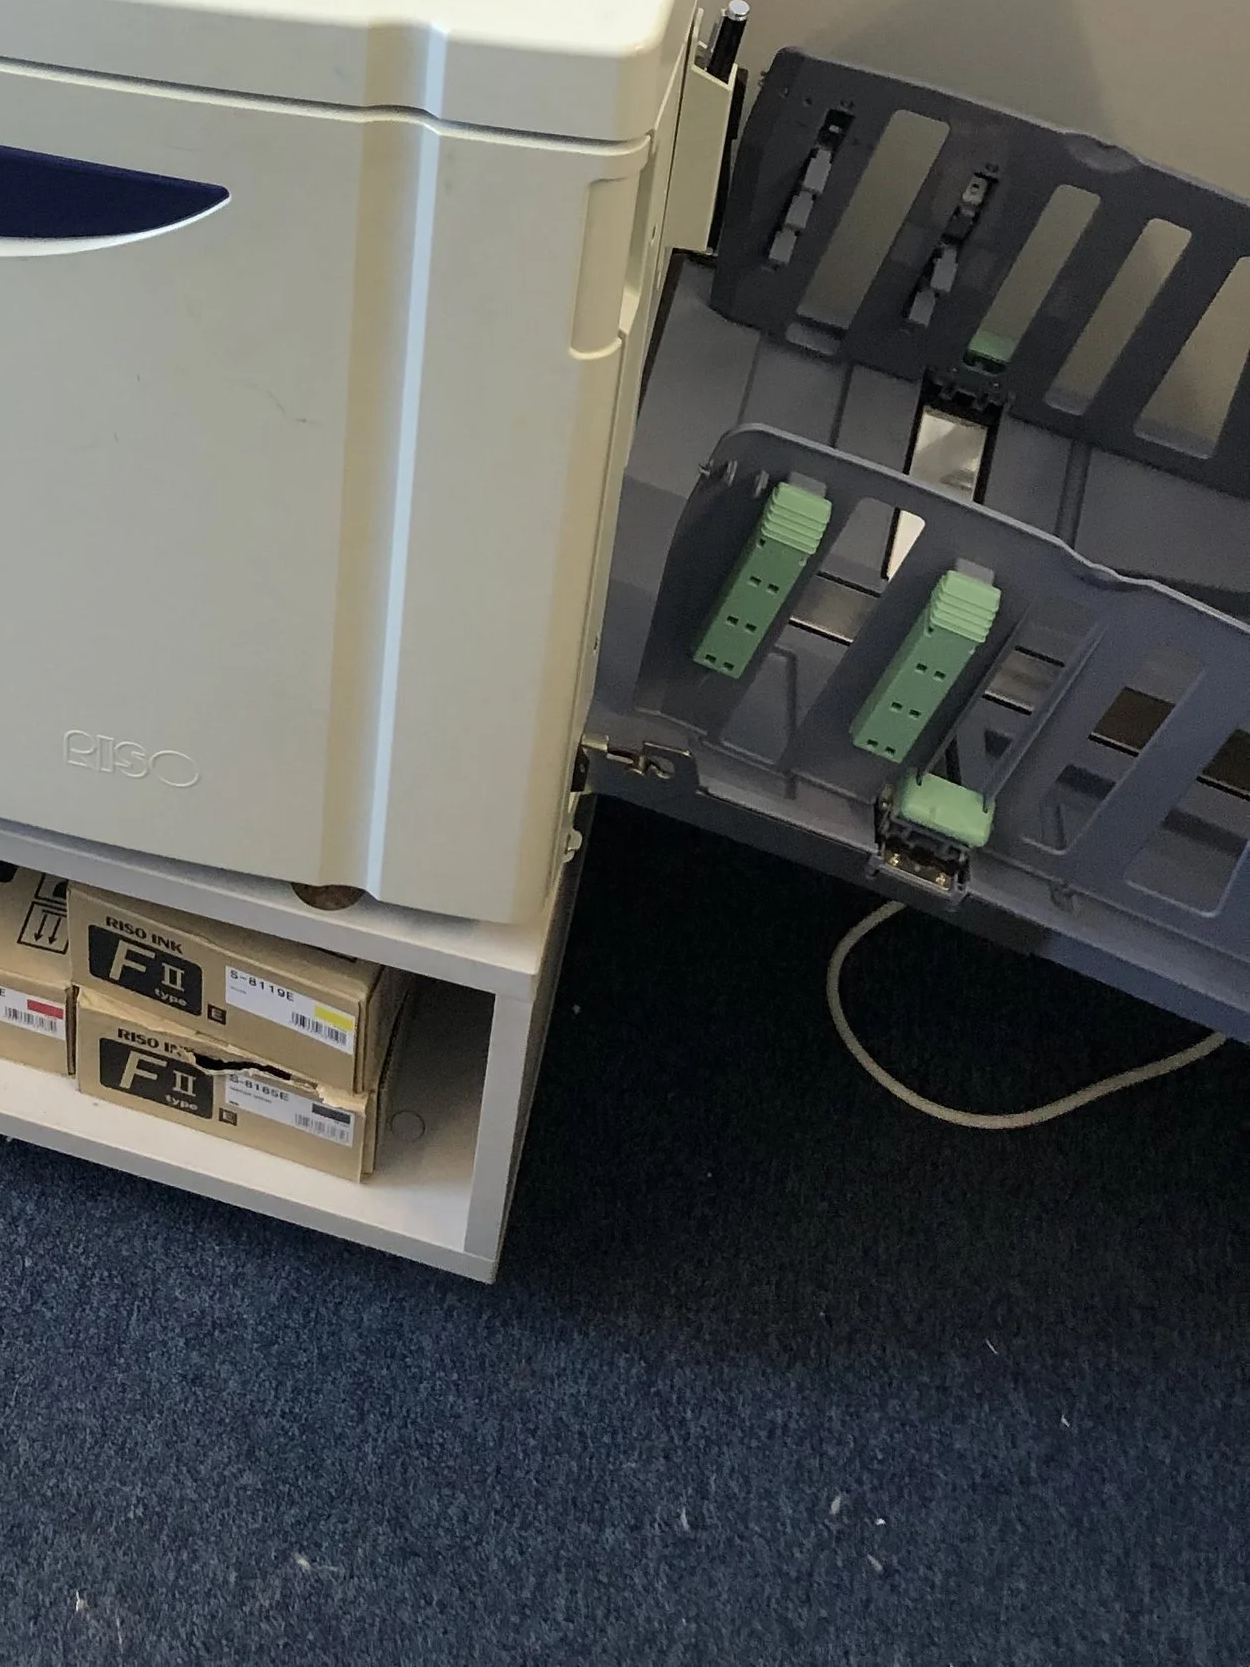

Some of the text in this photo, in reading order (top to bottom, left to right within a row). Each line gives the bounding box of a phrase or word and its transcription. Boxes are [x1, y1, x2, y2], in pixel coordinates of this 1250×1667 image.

[63, 729, 200, 788] RISO
[106, 916, 183, 955] RISO INK
[108, 940, 156, 981] F
[154, 987, 187, 1007] type
[230, 970, 294, 1002] S-8119E
[117, 1028, 159, 1050] RISO
[119, 1050, 167, 1090] F
[166, 1093, 198, 1111] type
